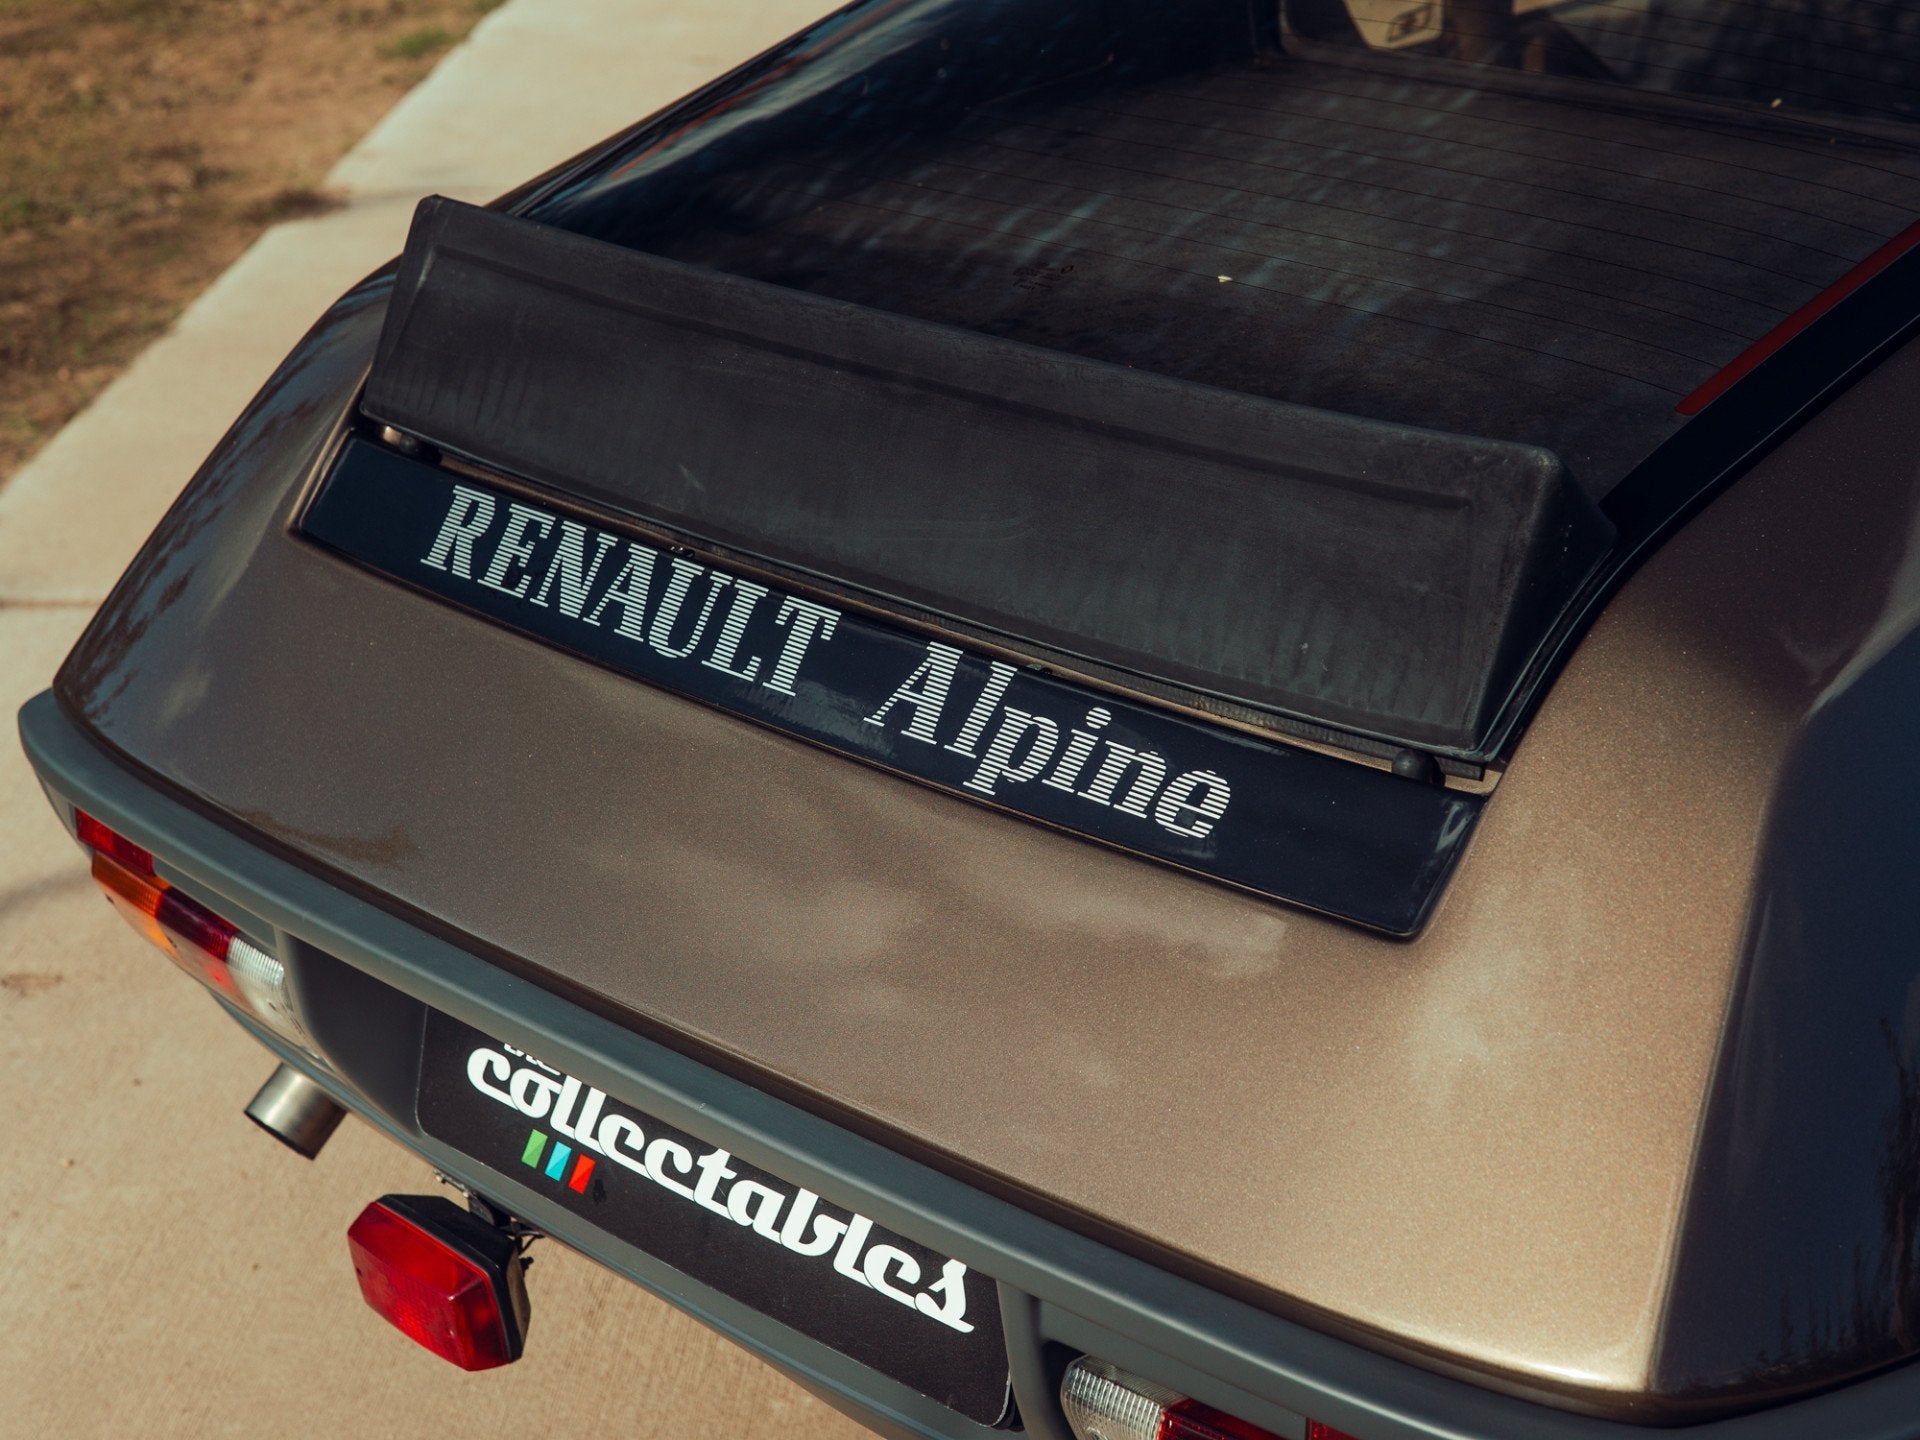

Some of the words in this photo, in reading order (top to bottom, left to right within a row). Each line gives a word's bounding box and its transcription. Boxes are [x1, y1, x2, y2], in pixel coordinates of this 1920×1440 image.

[420, 484, 842, 696] RENAULT
[863, 640, 1231, 839] Alpine
[467, 1047, 974, 1333] collectables
